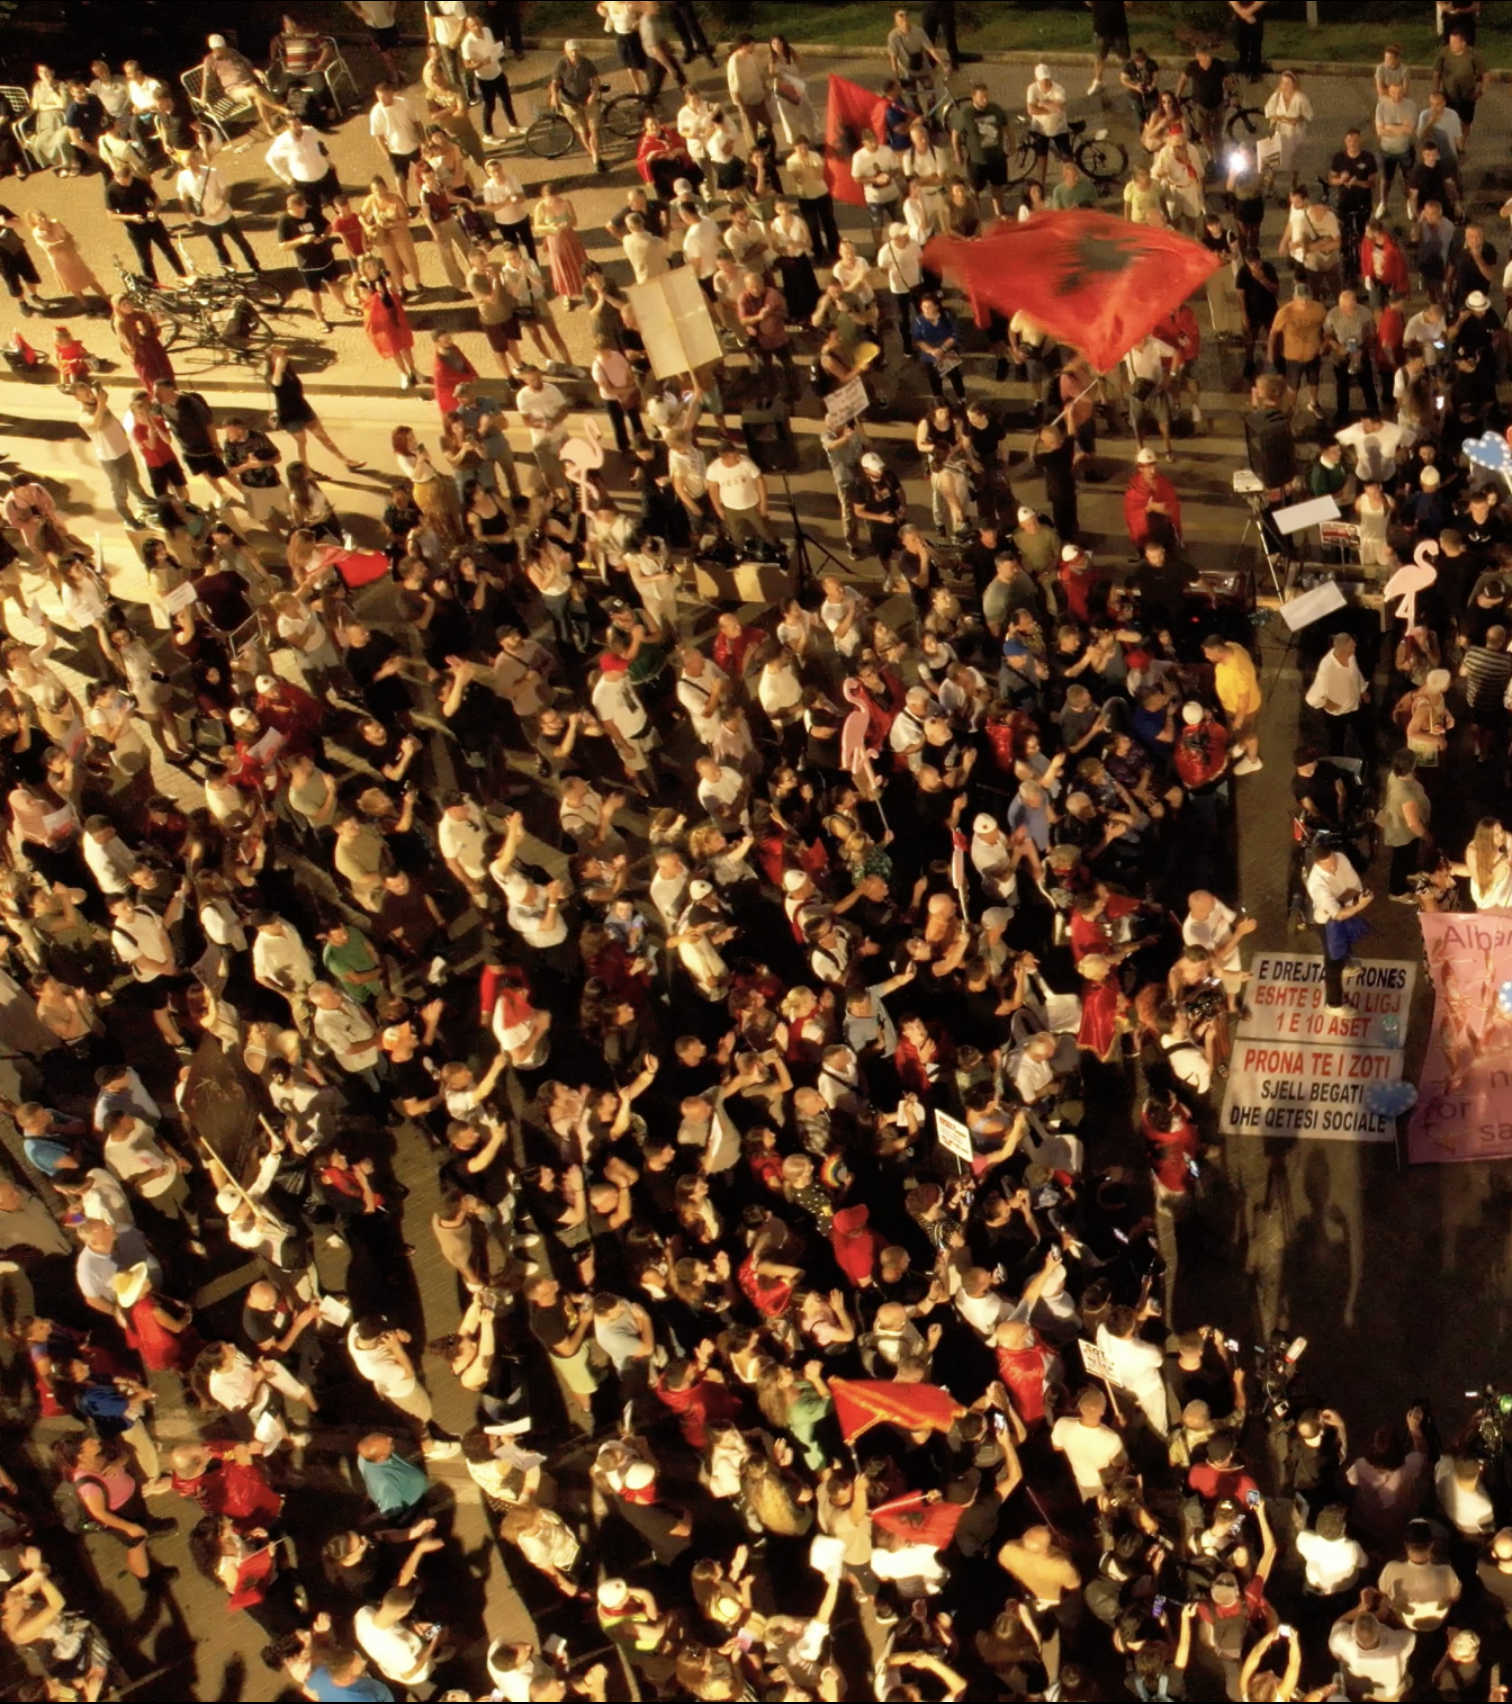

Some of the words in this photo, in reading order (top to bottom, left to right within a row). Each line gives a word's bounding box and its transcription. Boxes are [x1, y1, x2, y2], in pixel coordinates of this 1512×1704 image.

[1258, 960, 1269, 980] E
[1254, 985, 1308, 1009] ESHTE
[1312, 988, 1322, 1009] 9
[1364, 993, 1400, 1014] LIGJ
[1276, 1014, 1284, 1032] 1
[1289, 1013, 1300, 1033] E
[1306, 1014, 1324, 1036] 10
[1328, 1016, 1371, 1037] ASET
[1243, 1048, 1305, 1076] PRONA
[1311, 1053, 1333, 1076] TE
[1337, 1054, 1345, 1077] I
[1348, 1055, 1391, 1079] ZOTI
[1261, 1079, 1305, 1101] SJELL
[1310, 1082, 1364, 1104] BEGATI
[1230, 1106, 1260, 1126] DHE
[1264, 1107, 1319, 1130] QETESI
[1322, 1110, 1387, 1133] SOCIALE
